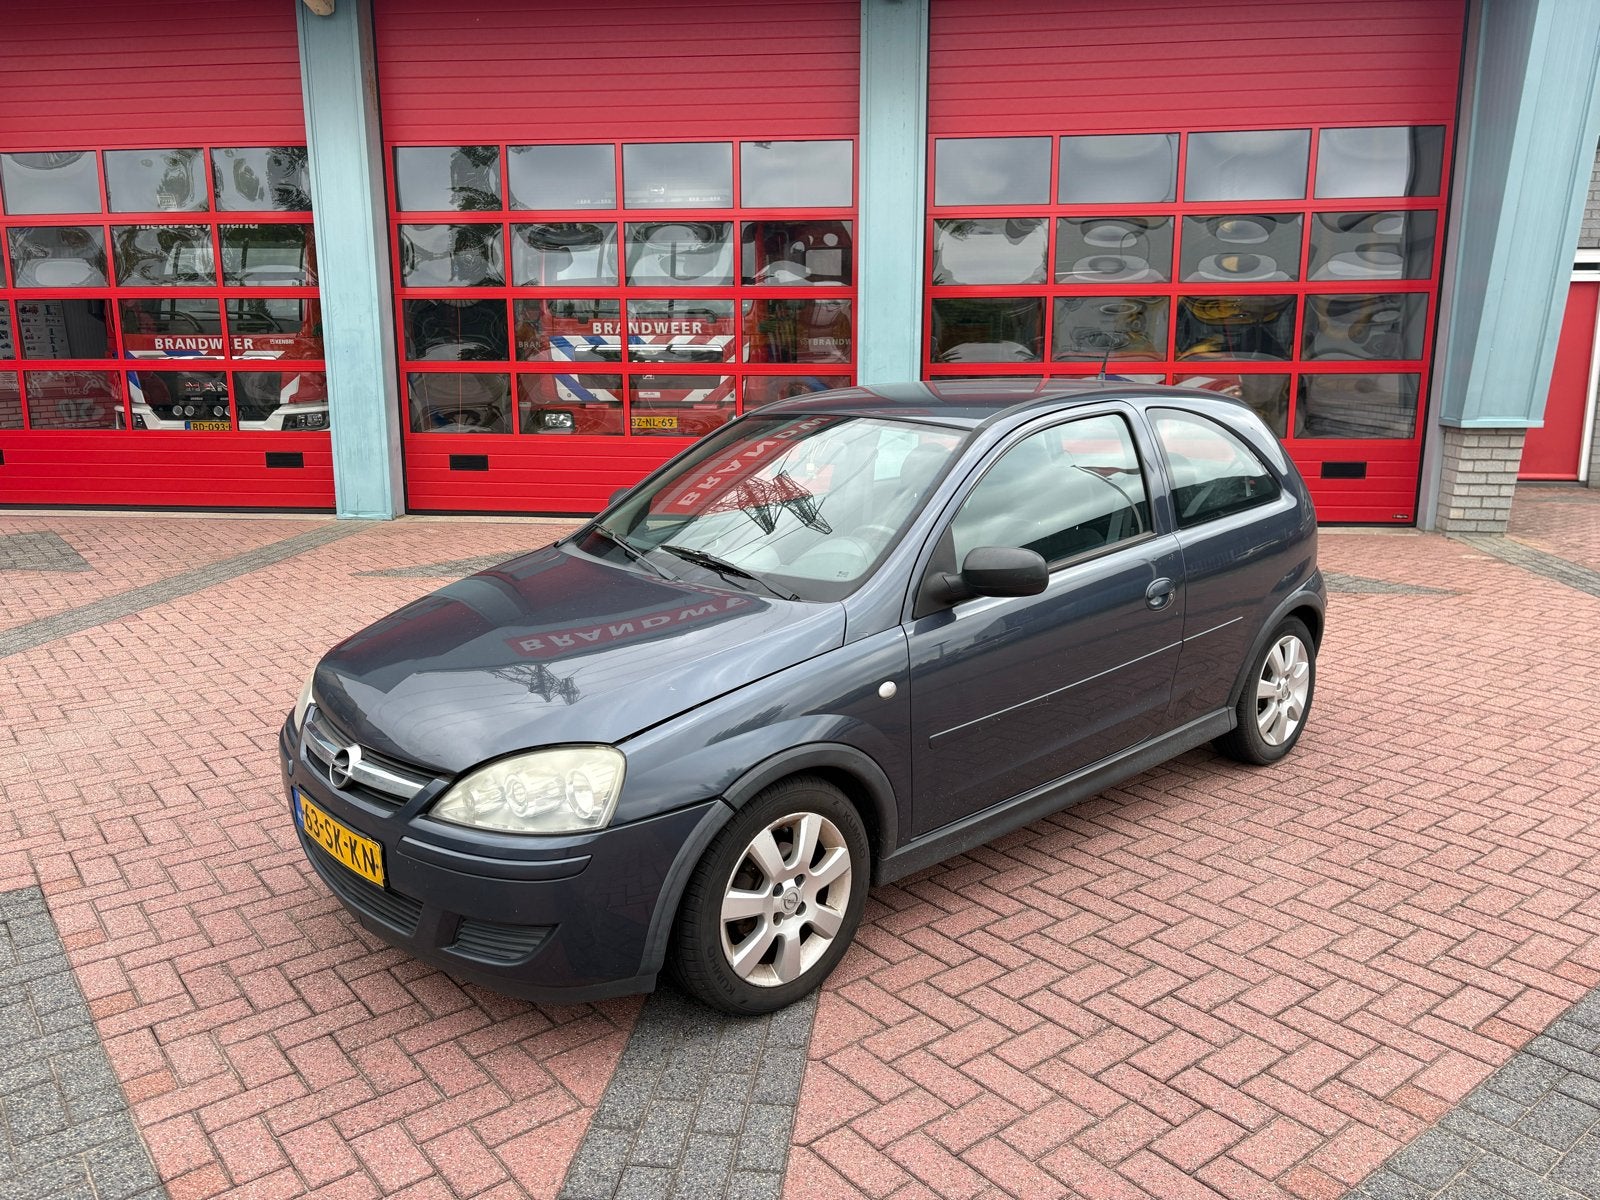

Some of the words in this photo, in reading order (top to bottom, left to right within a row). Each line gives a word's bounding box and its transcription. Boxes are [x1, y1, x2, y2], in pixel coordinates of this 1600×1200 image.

[154, 338, 254, 350] BRANDWER
[631, 418, 674, 427] BZ-NL-69
[304, 803, 378, 877] 63-SK-KN
